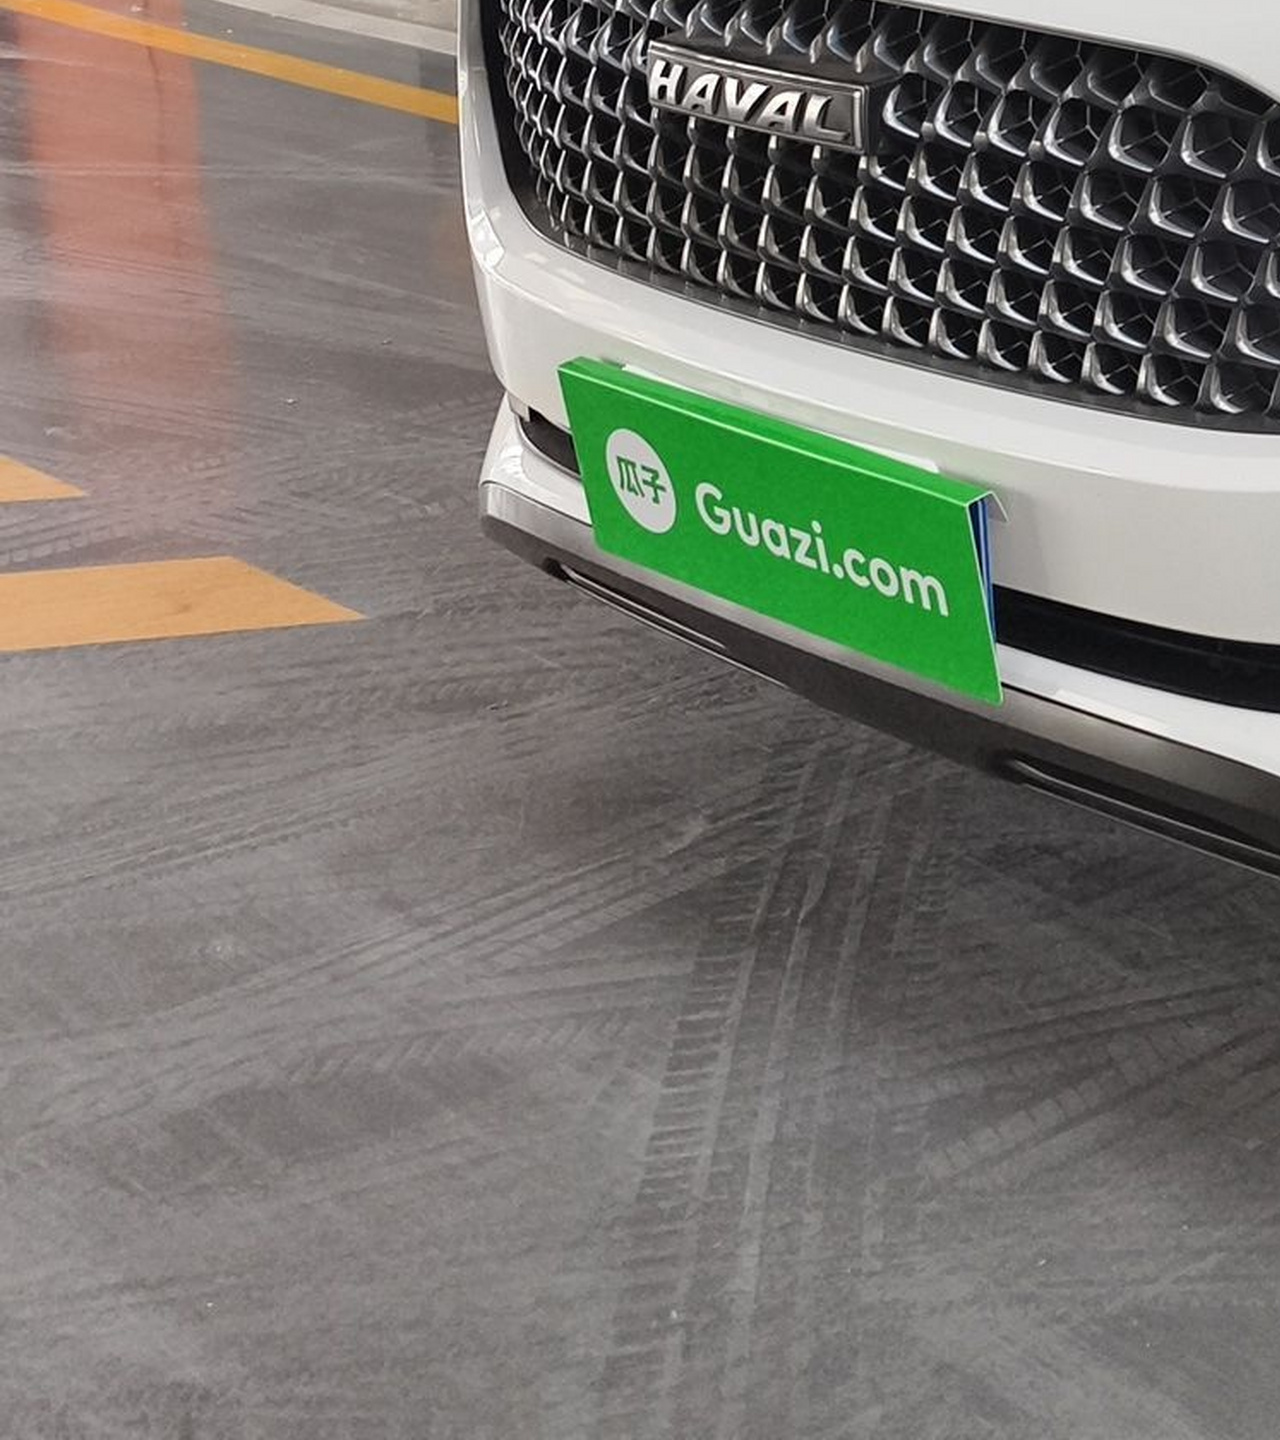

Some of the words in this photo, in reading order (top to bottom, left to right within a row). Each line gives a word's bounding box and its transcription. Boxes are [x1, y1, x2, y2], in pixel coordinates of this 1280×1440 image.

[649, 59, 850, 142] HAVAL
[616, 455, 667, 505] 瓜子
[695, 482, 949, 617] Guazi.com
